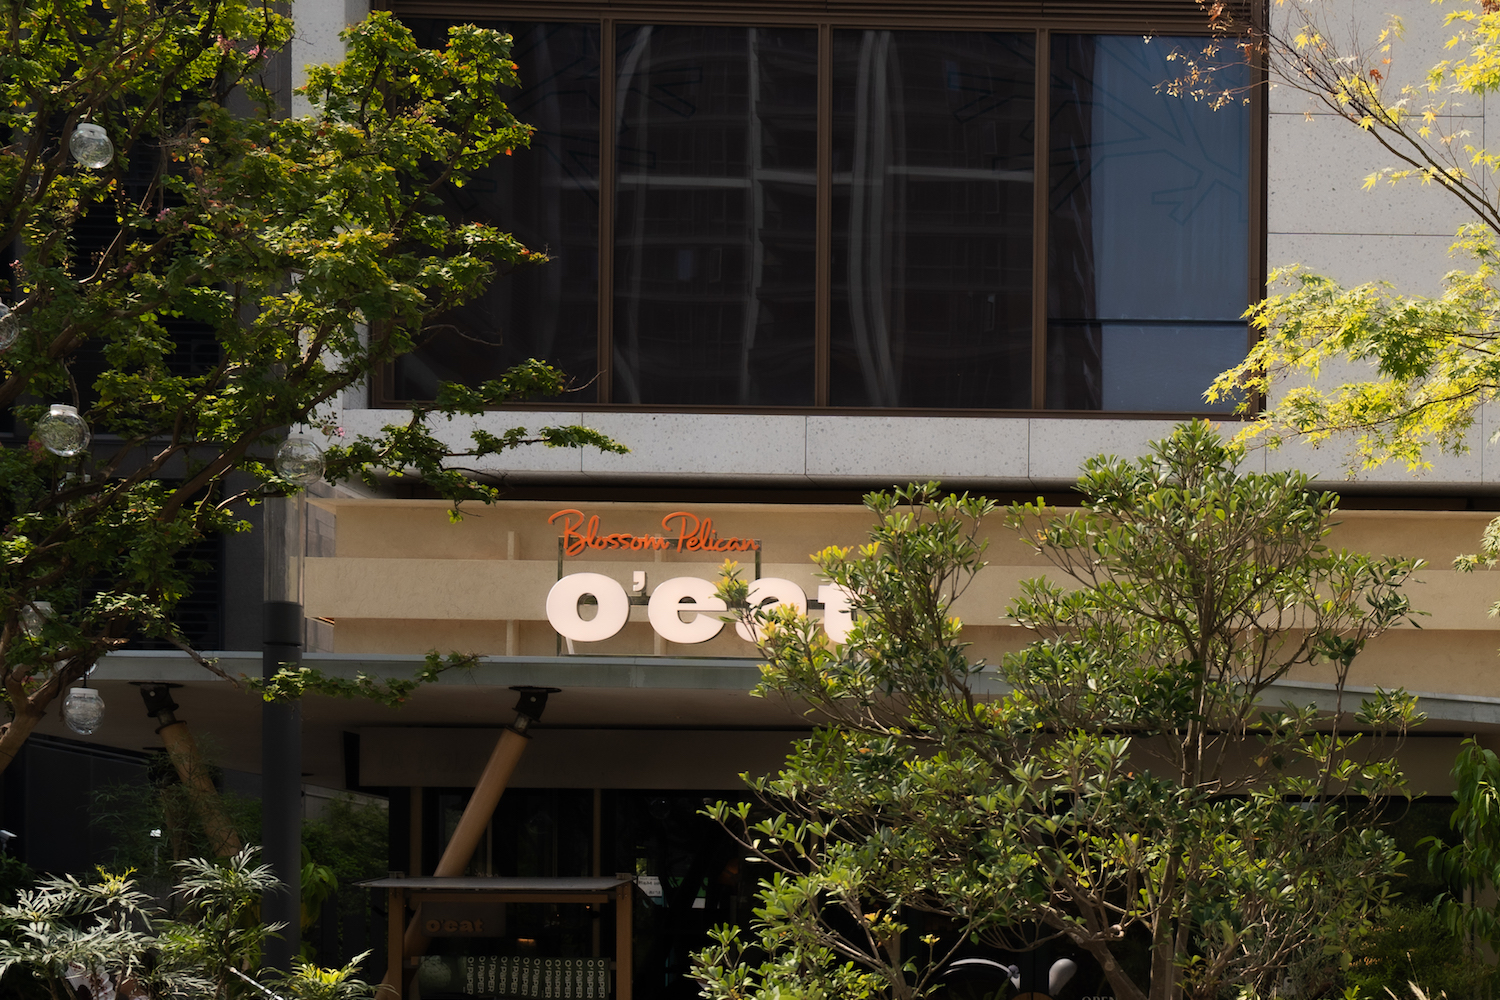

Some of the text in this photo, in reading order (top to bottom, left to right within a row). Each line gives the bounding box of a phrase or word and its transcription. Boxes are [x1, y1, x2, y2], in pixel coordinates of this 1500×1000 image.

[548, 508, 761, 557] Blossom Pelican
[546, 570, 866, 645] o'eat
[425, 918, 485, 934] o'eat
